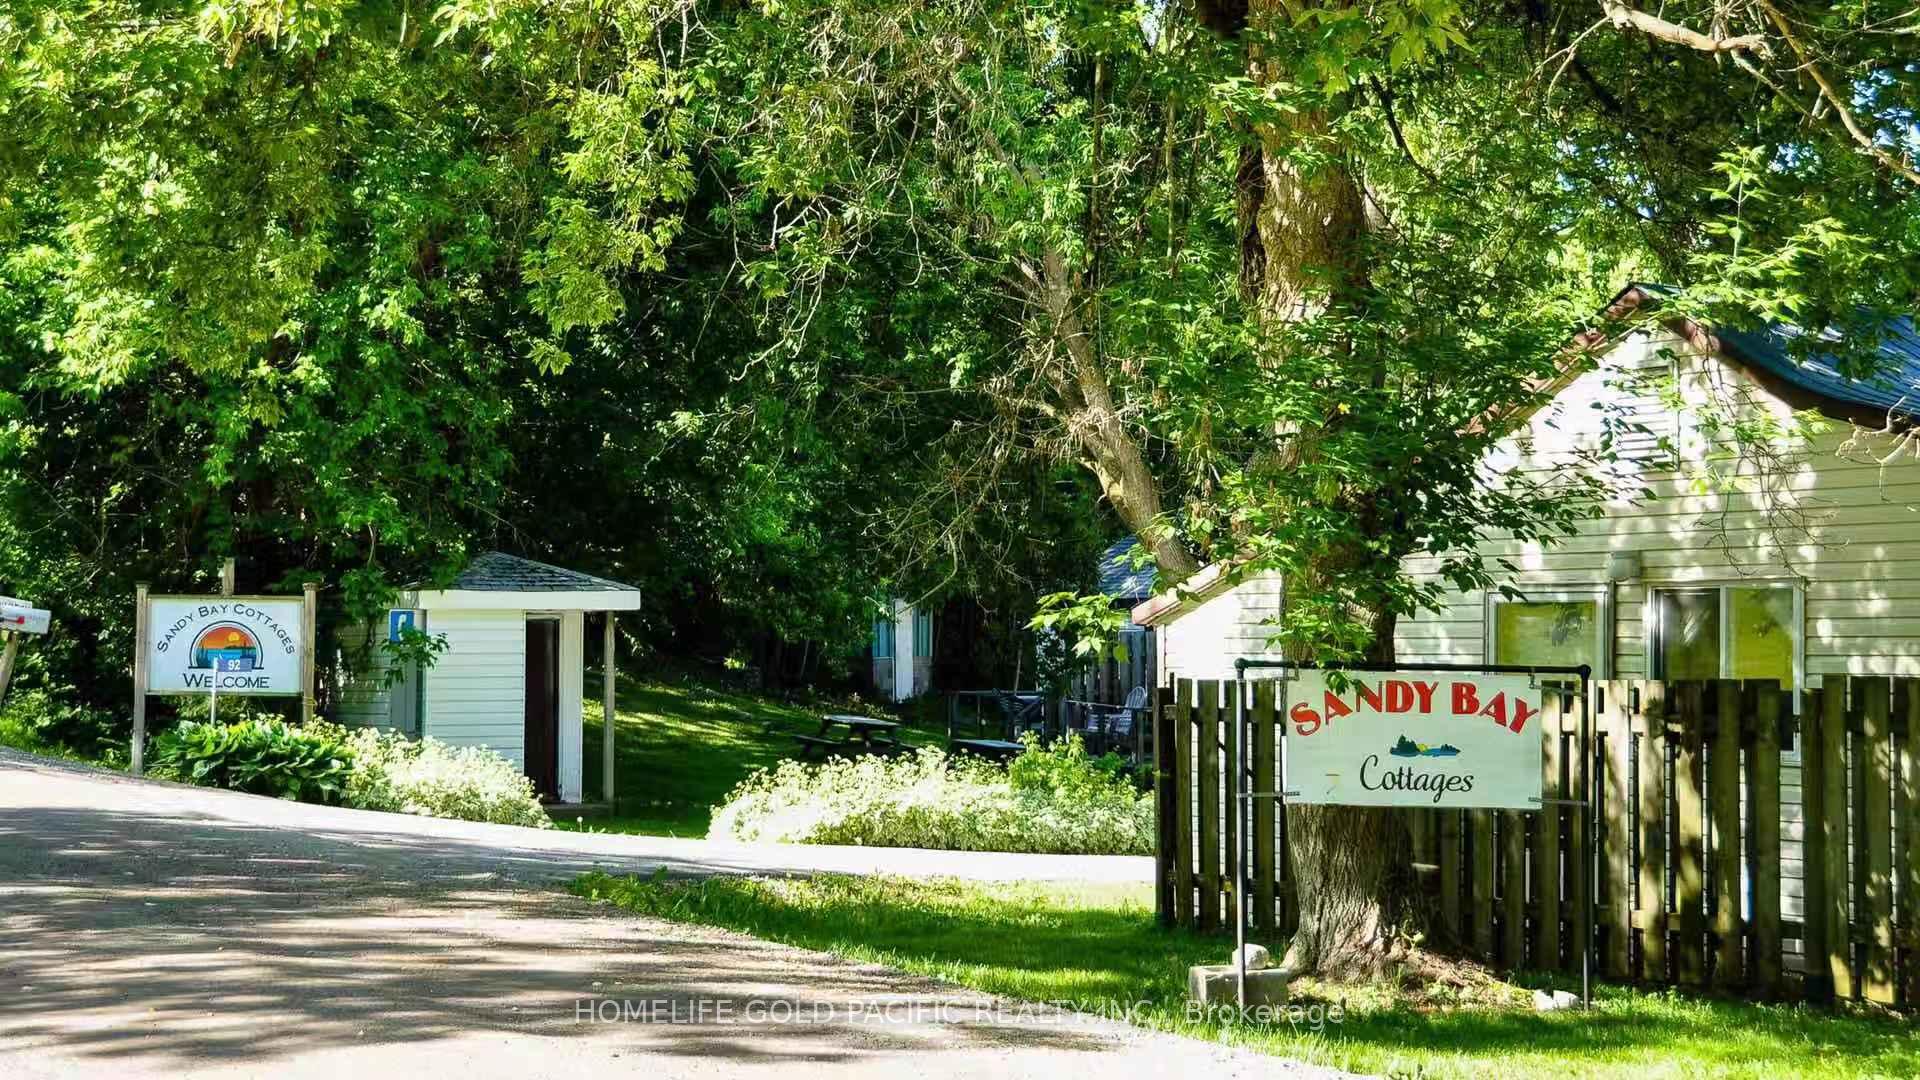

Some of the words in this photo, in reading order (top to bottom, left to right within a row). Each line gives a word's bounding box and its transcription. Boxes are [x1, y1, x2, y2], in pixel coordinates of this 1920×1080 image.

[158, 613, 194, 652] SANDY
[198, 605, 229, 617] BAY
[233, 604, 295, 654] COTTAGES
[183, 673, 270, 688] WELCOME
[228, 659, 241, 671] 92
[1290, 679, 1439, 736] SANDY
[1451, 682, 1539, 734] BAY
[1359, 754, 1475, 803] Cottages
